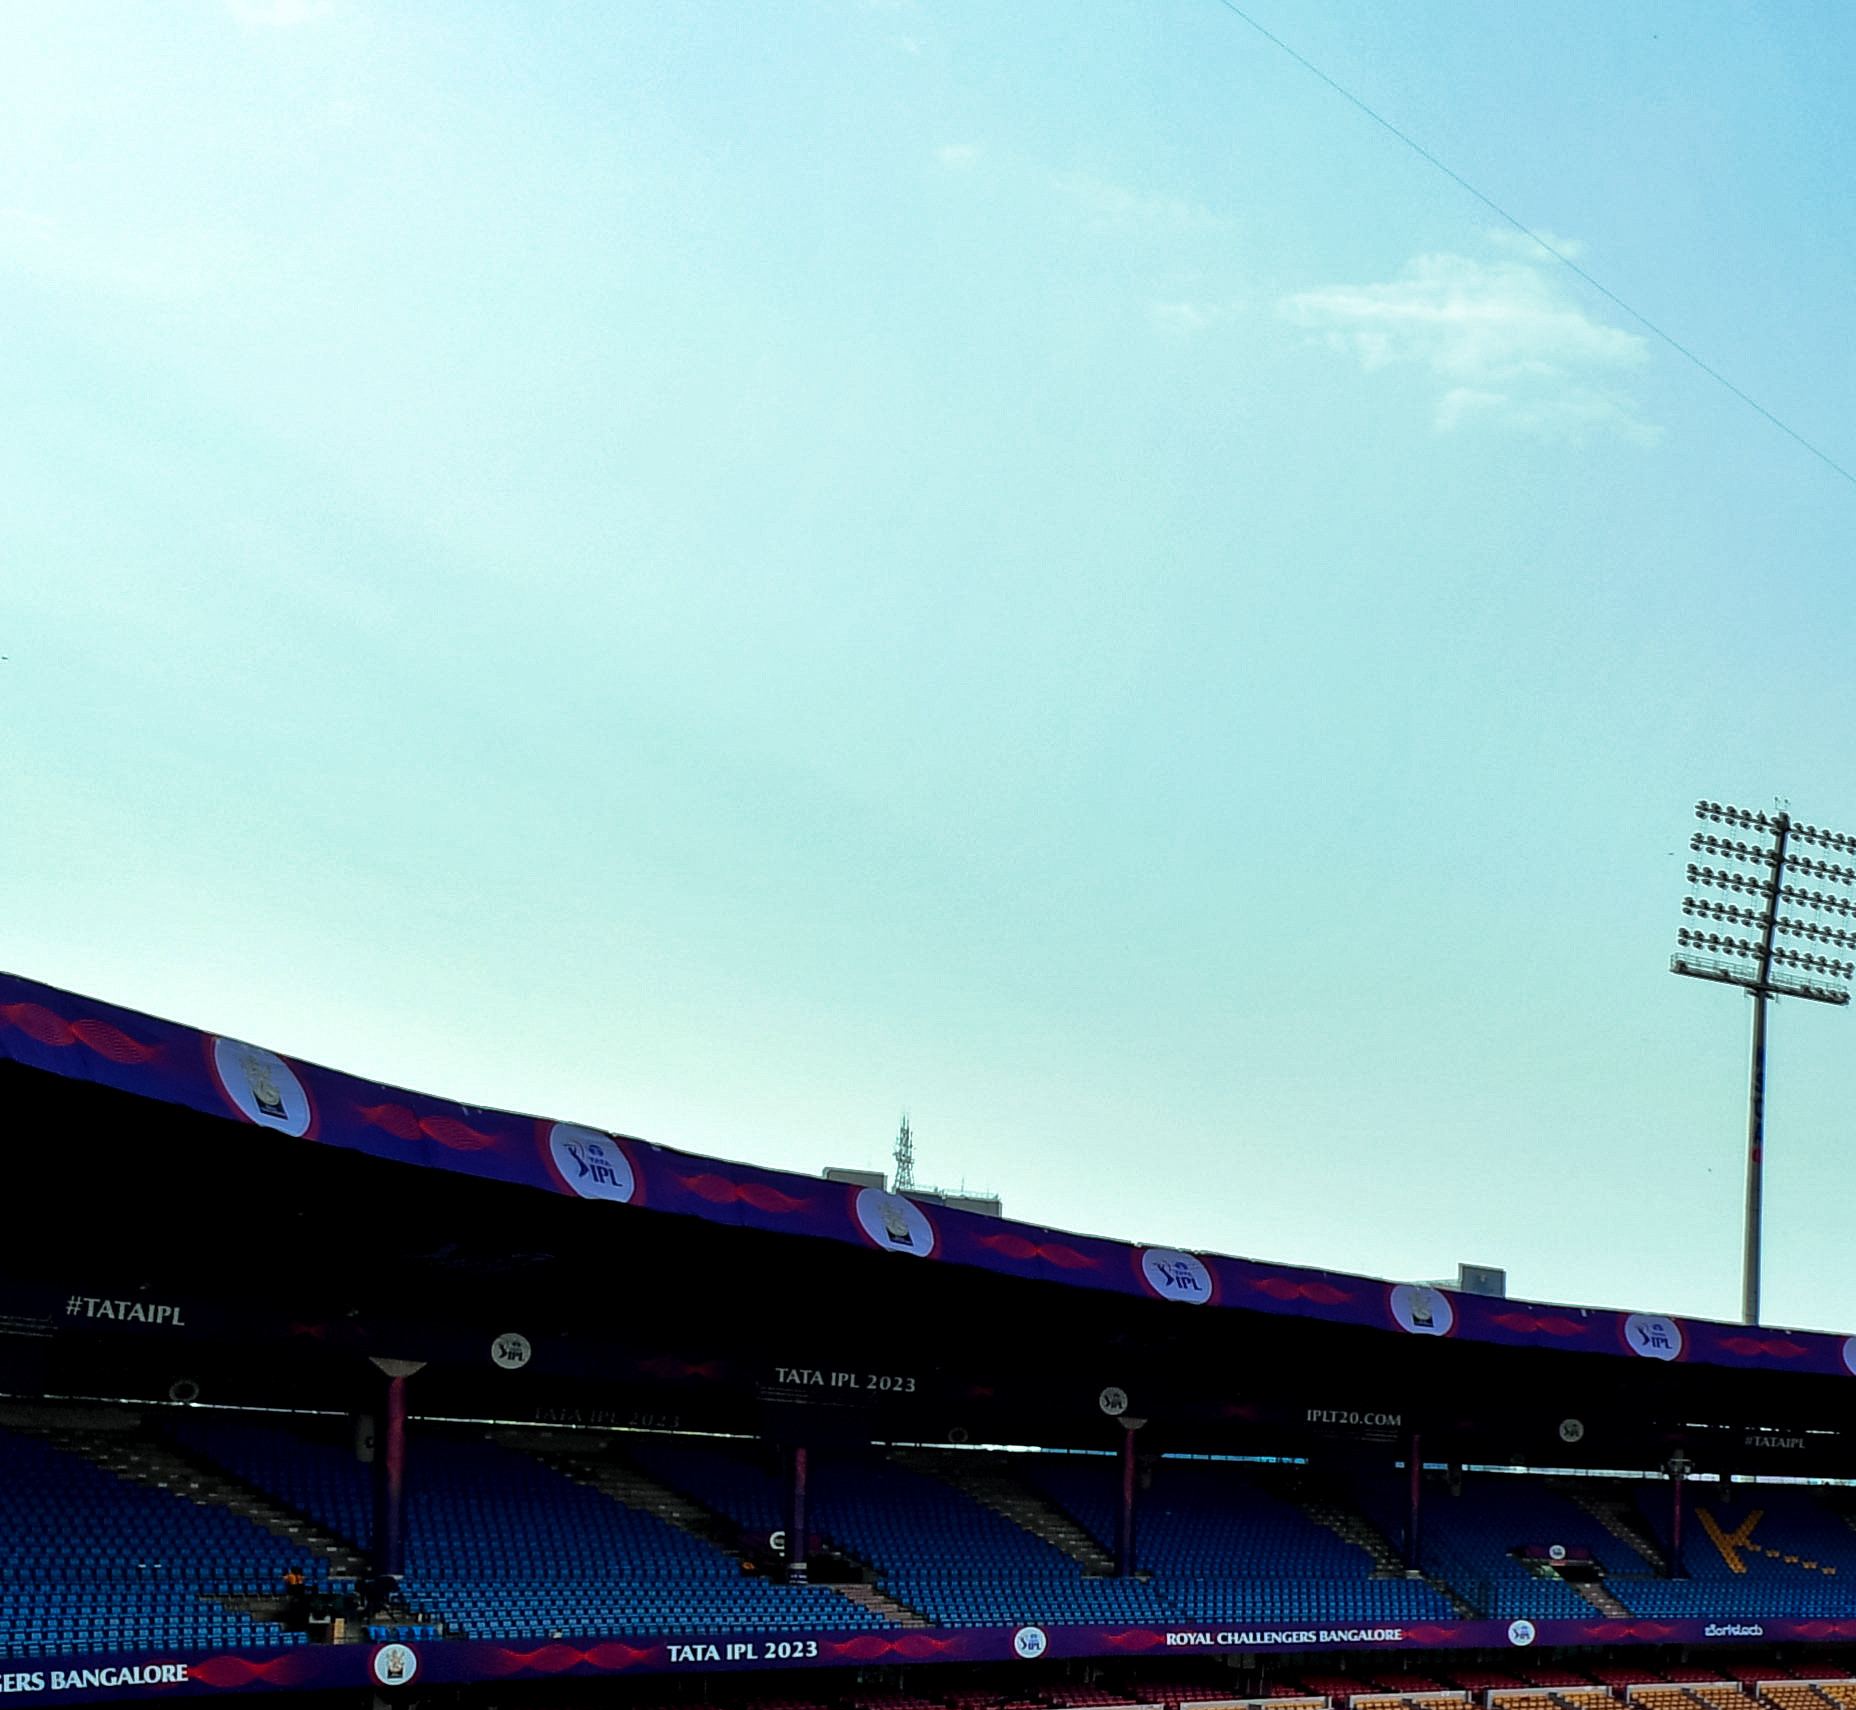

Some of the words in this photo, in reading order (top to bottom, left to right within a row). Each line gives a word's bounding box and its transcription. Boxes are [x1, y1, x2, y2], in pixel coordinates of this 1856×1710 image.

[590, 1165, 624, 1188] IPL
[1174, 1275, 1203, 1292] IPL
[66, 1295, 185, 1327] #TATAIPL
[1651, 1336, 1674, 1350] IPL
[775, 1367, 825, 1386] TATA
[831, 1371, 861, 1389] IPL
[866, 1374, 916, 1393] 2023
[1307, 1409, 1402, 1427] IPLT20.COM
[1744, 1434, 1807, 1450] #TATAIPL
[1166, 1632, 1215, 1646] ROYAL
[1217, 1630, 1317, 1645] CHALLENGERS
[1319, 1629, 1403, 1643] BANGALORE
[667, 1644, 721, 1662] TATA
[726, 1643, 759, 1661] IPL
[764, 1641, 819, 1659] 2023
[50, 1663, 189, 1691] BANGALORE
